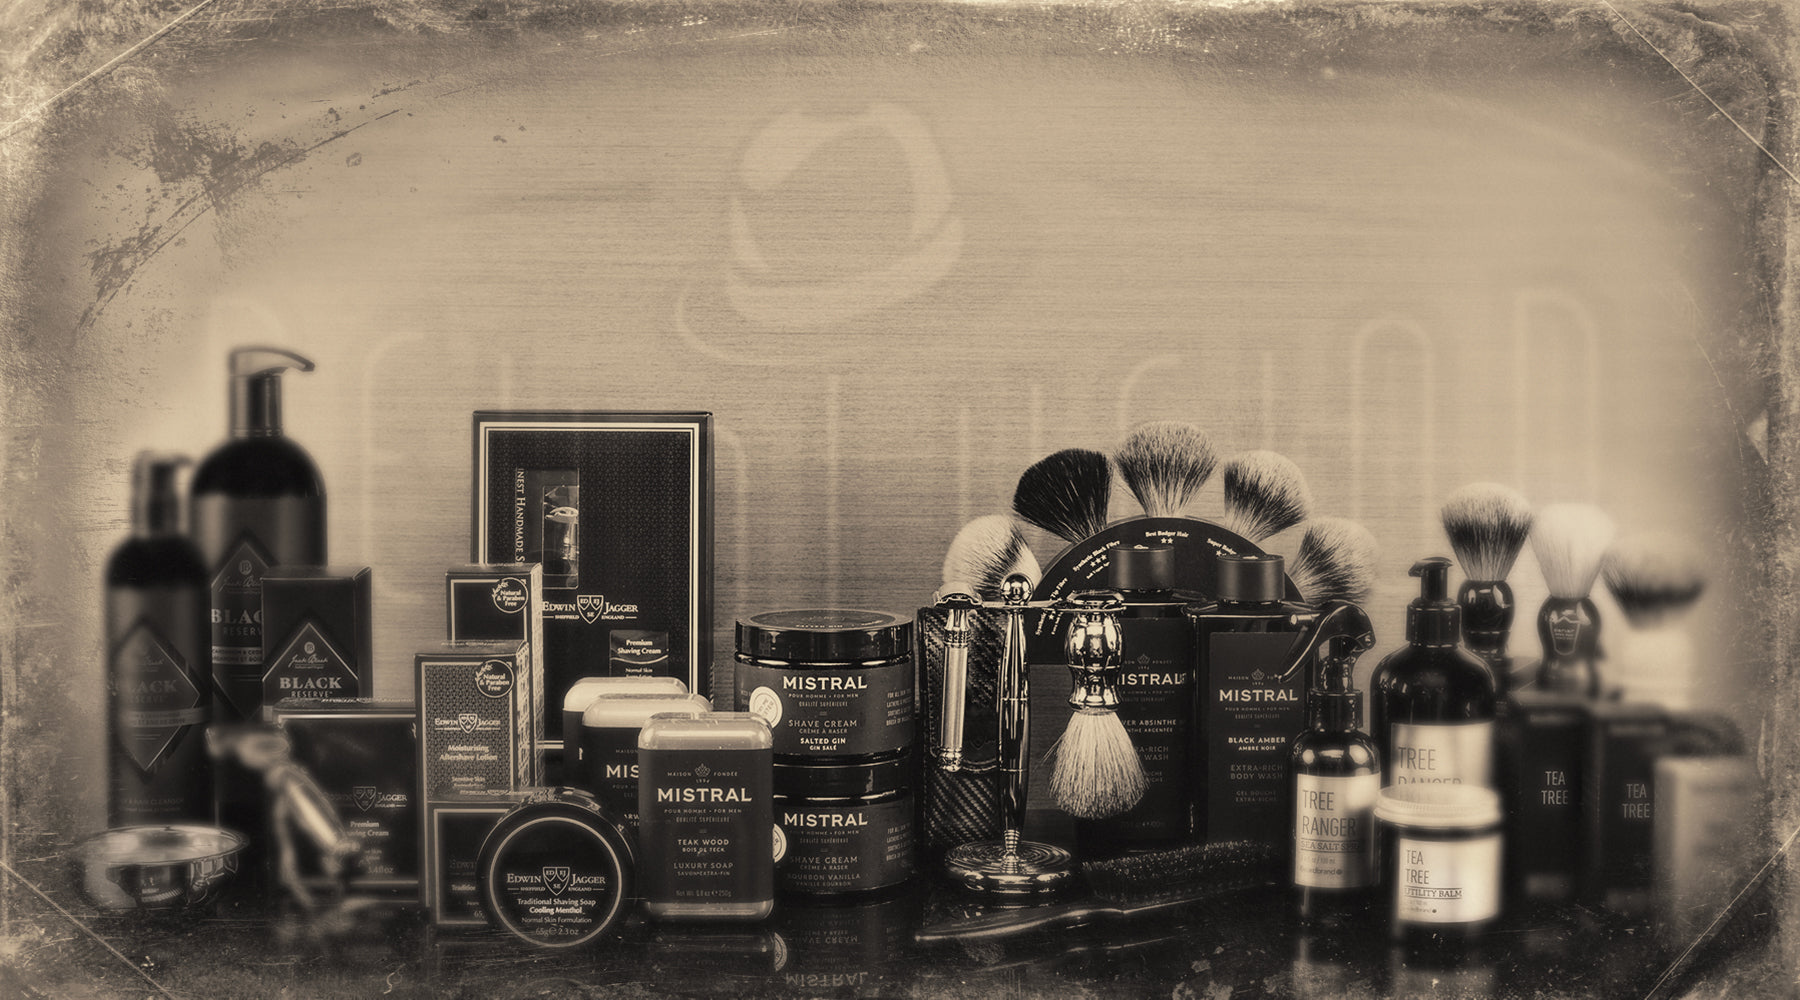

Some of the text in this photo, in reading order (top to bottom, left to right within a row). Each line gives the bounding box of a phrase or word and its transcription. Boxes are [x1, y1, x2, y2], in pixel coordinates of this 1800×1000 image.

[515, 498, 525, 553] HANDMADE
[542, 602, 638, 614] EDWIN JAGGER
[211, 608, 262, 624] BLAC
[618, 648, 640, 656] Shaving
[280, 677, 340, 689] BLACK
[783, 676, 868, 690] MISTRAL
[1121, 673, 1182, 686] ISTRAL
[1219, 689, 1298, 702] MISTRAL
[788, 720, 858, 728] SHAVE CREAM
[1398, 747, 1436, 770] TREE
[1545, 771, 1566, 786] TEA
[657, 787, 752, 802] MISTRAL
[1541, 790, 1568, 805] TREE
[1626, 784, 1647, 799] TEA
[1302, 790, 1335, 811] TREE
[1622, 803, 1650, 818] TREE
[784, 812, 868, 827] MISTRAL
[1302, 816, 1356, 836] RANGER
[1317, 842, 1340, 850] SALT
[824, 856, 858, 864] CREAM
[1406, 849, 1424, 865] TEA
[506, 873, 606, 886] EDWIN JAGGER
[1406, 868, 1429, 884] TREE
[1404, 888, 1437, 897] UTILITY
[553, 898, 579, 906] Shaving
[580, 899, 596, 907] Soap
[529, 906, 582, 915] Cooling Menthol
